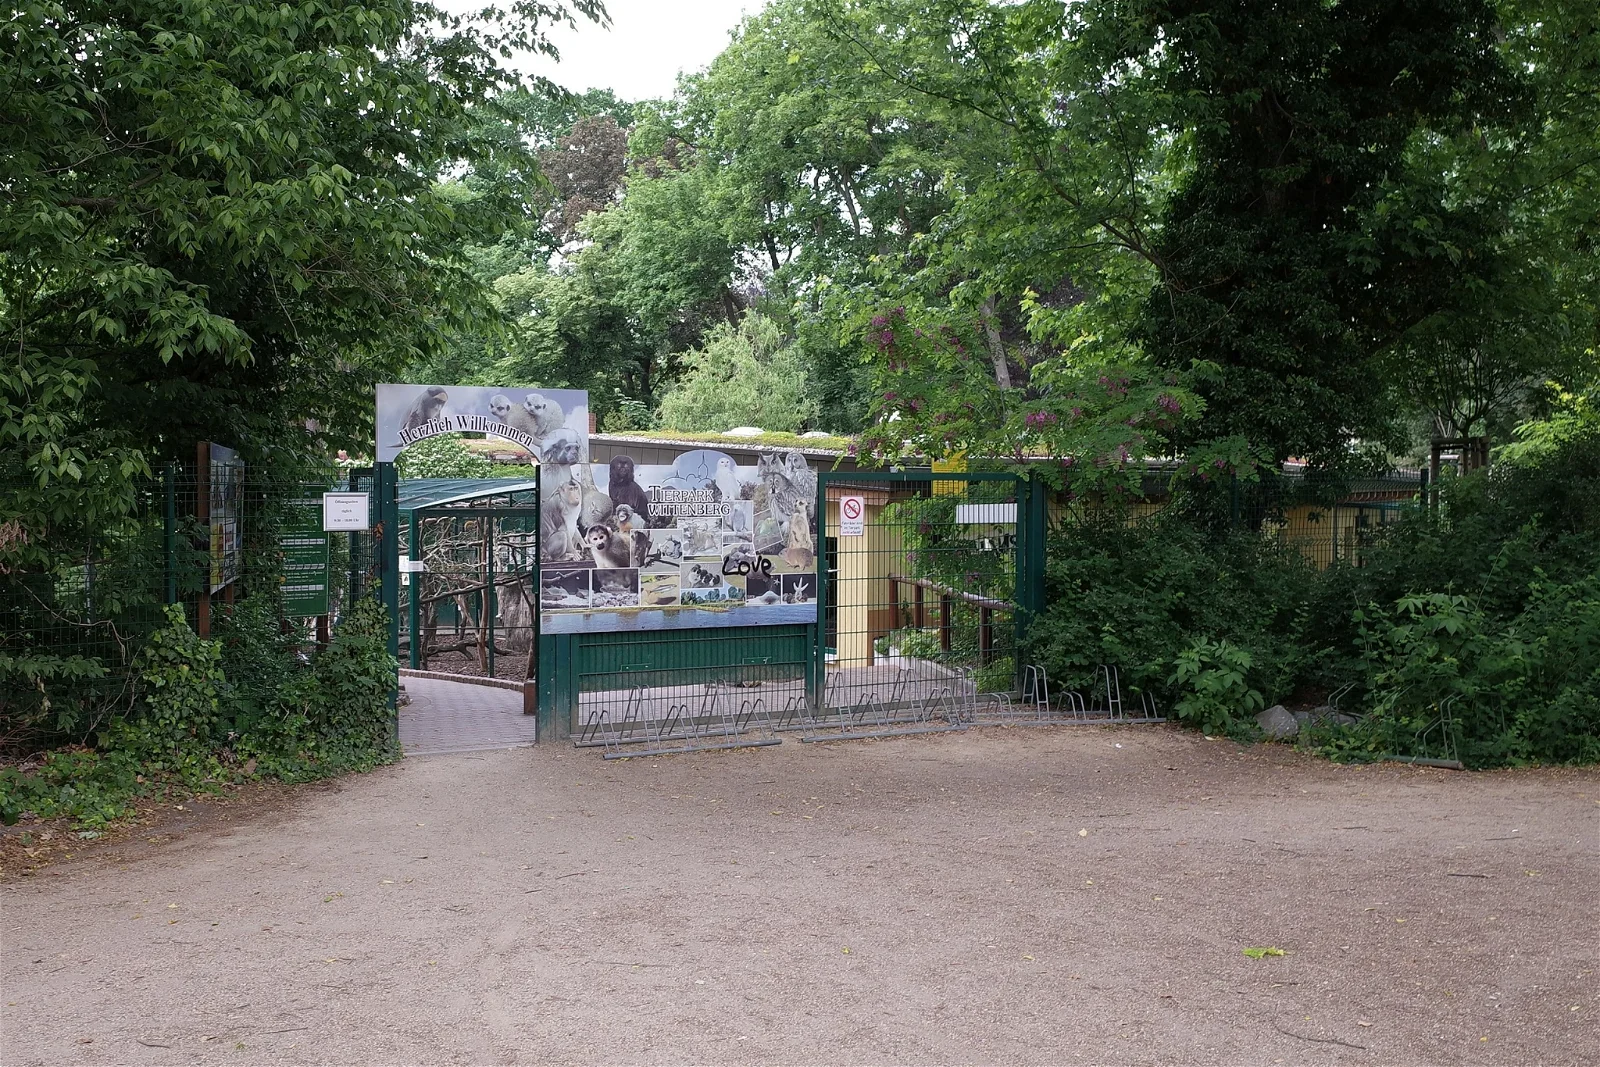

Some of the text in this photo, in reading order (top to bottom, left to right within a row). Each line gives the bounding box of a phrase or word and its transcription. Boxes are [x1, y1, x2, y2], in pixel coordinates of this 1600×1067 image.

[399, 415, 533, 447] Herzlich Willkommen
[648, 485, 714, 502] TIERPARK
[647, 503, 731, 516] WITTENBERG
